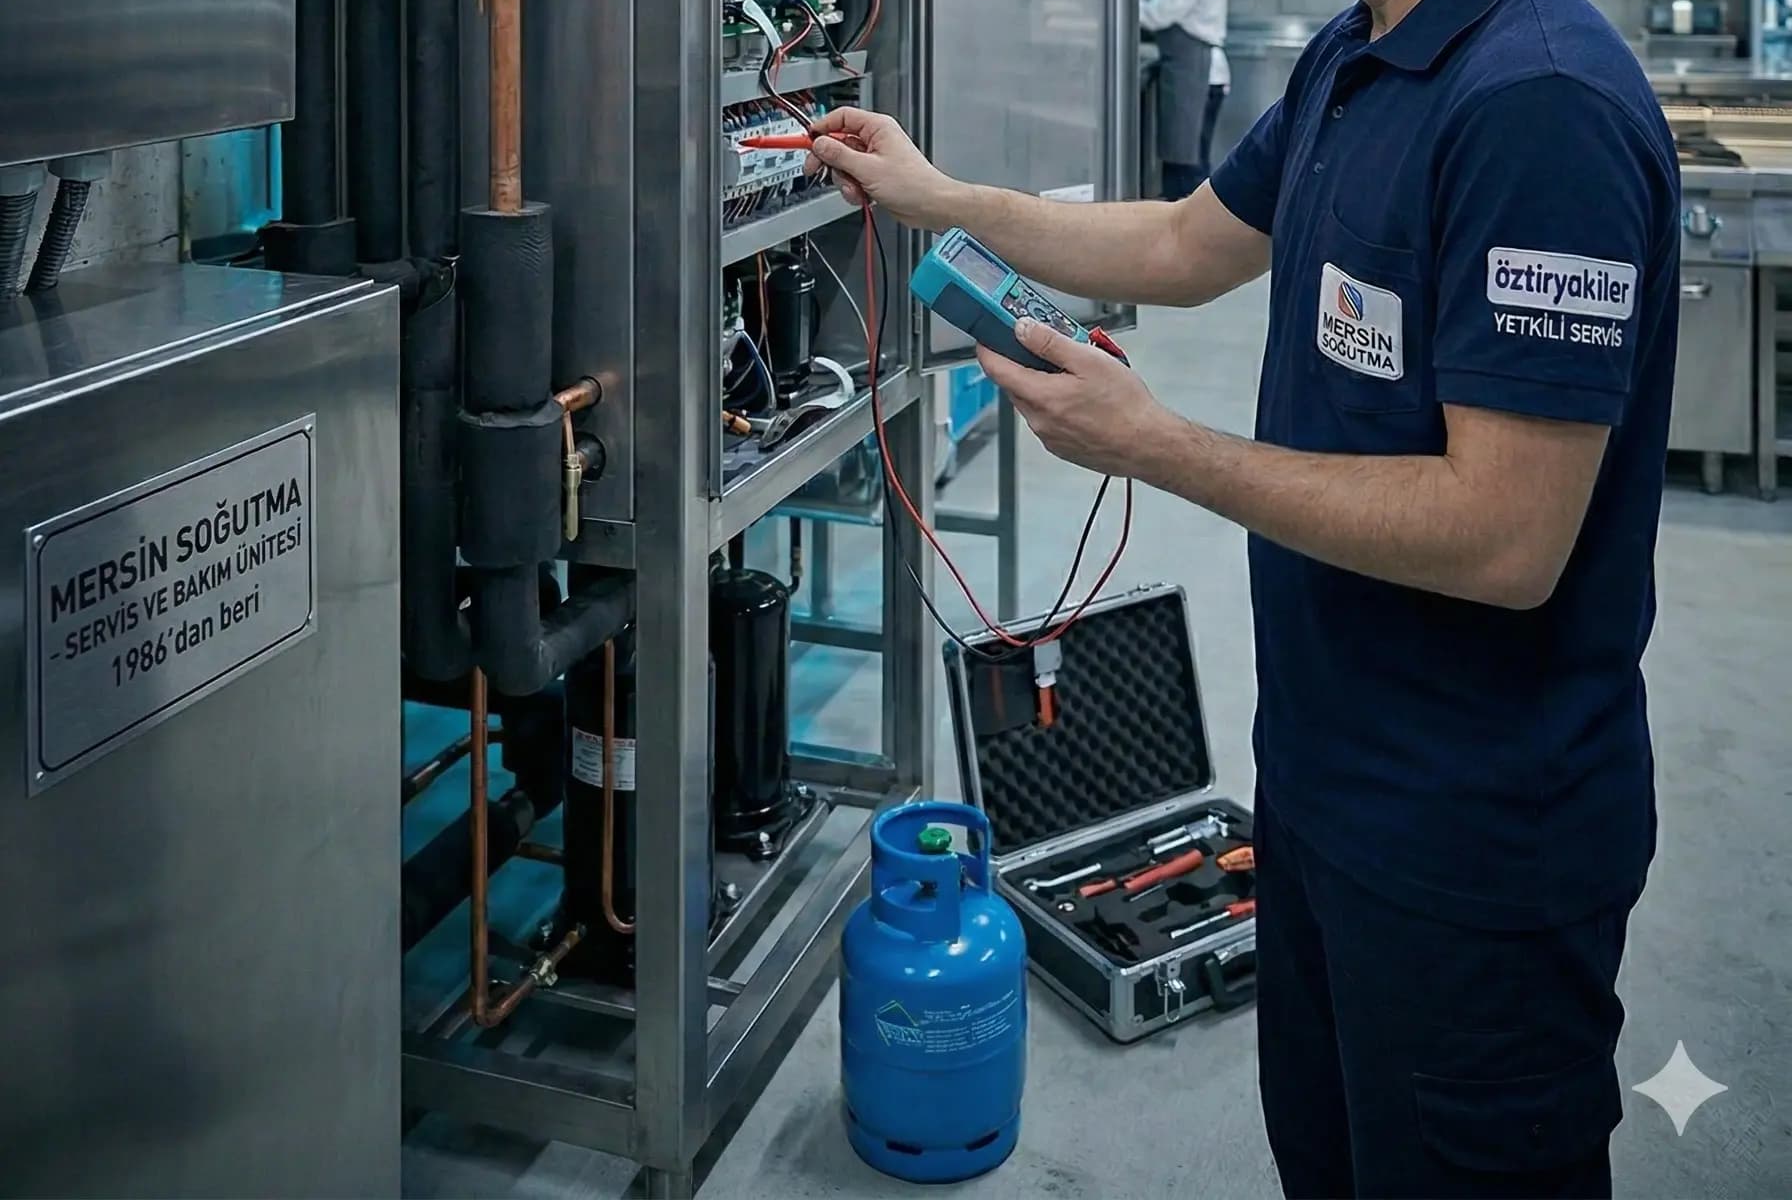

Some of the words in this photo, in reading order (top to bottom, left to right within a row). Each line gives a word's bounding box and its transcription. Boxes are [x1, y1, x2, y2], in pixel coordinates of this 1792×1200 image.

[1495, 259, 1629, 305] öztiryakiler
[1323, 312, 1393, 353] MERSİN
[1494, 312, 1565, 340] YETKİLİ
[1570, 322, 1623, 347] SERVİS
[51, 535, 168, 623] MERSİN
[176, 478, 302, 563] SOĞUTMA
[65, 602, 139, 660] SERVİS
[143, 587, 168, 621] VE
[173, 556, 231, 607] BAKIM
[236, 516, 301, 574] ÜNİTESİ
[112, 616, 213, 687] 1986'dan
[220, 583, 259, 630] beri
